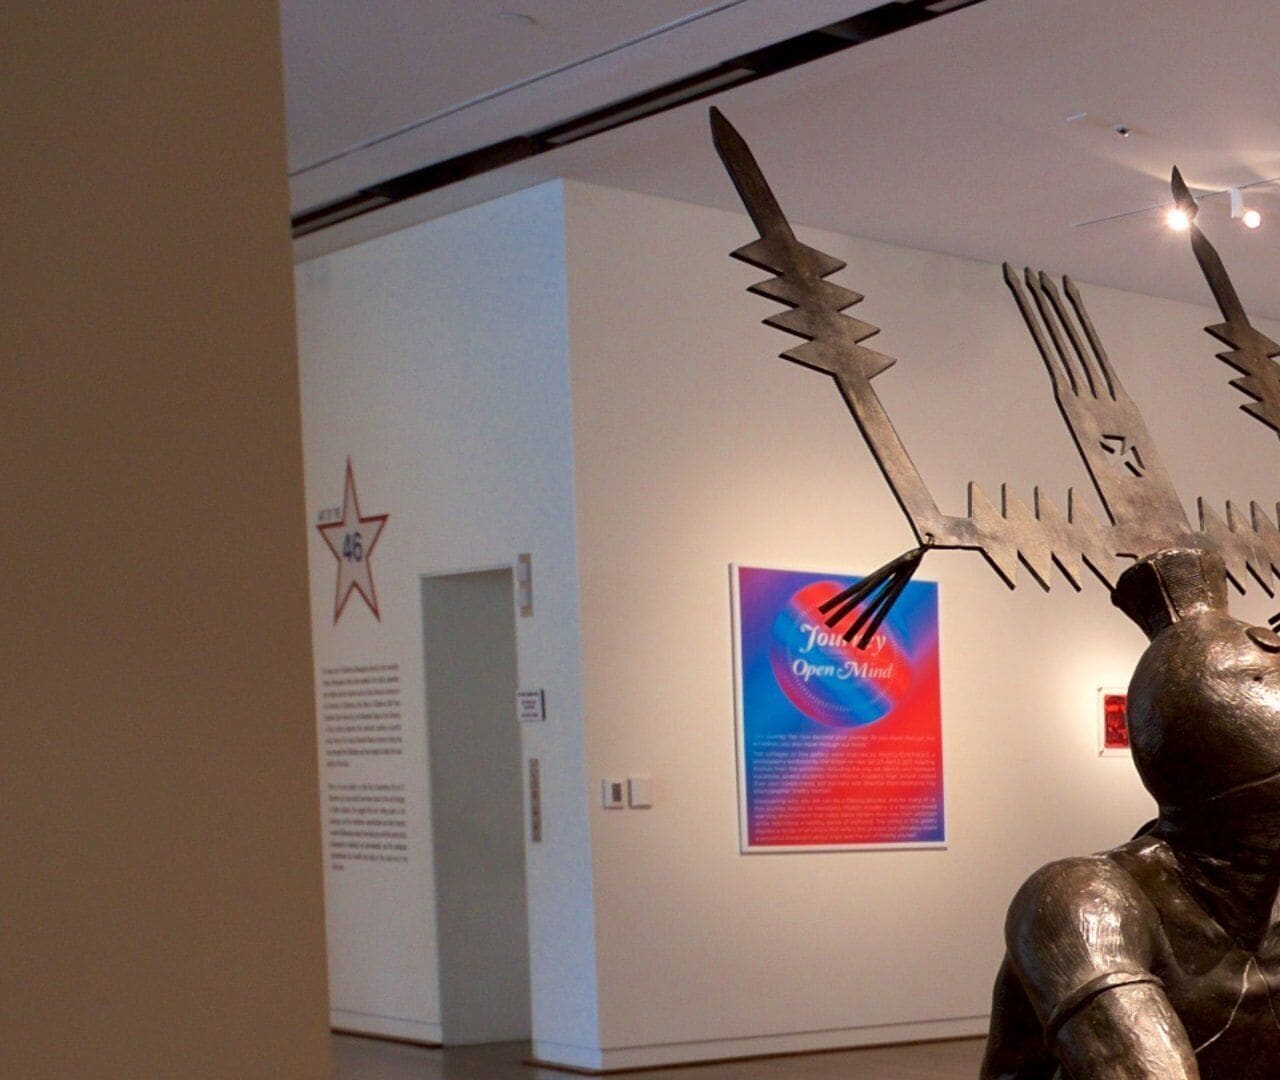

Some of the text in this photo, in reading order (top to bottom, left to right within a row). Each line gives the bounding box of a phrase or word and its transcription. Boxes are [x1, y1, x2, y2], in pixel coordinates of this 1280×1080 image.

[343, 531, 363, 562] 46
[799, 623, 887, 657] Jouy
[792, 658, 894, 682] Open Mind
